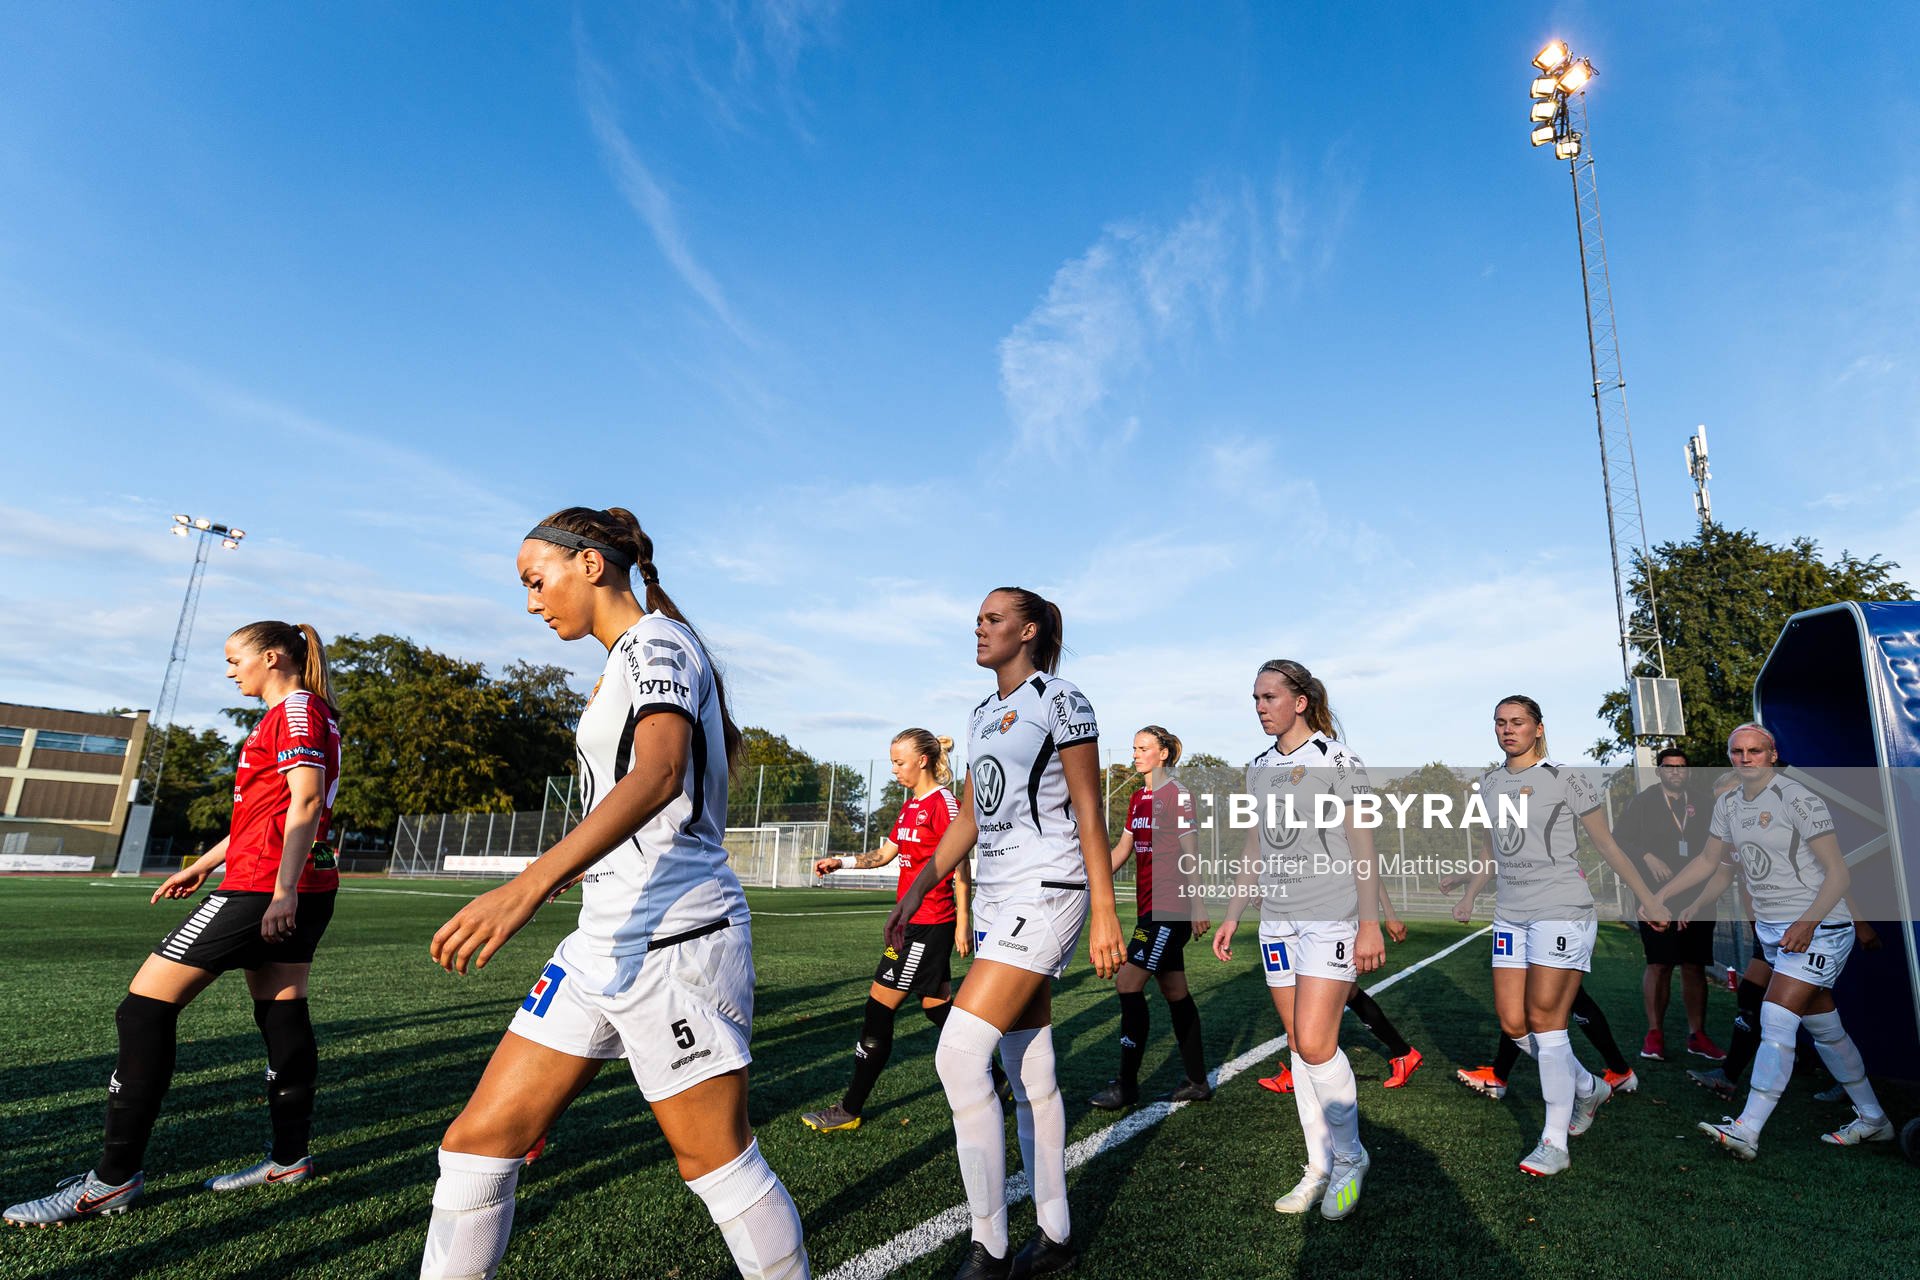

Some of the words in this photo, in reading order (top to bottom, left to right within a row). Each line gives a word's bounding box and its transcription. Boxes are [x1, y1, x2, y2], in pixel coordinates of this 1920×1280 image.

[1052, 694, 1067, 726] RASTA
[1333, 754, 1346, 781] RASTA
[1566, 776, 1584, 798] RASTA
[1790, 799, 1809, 821] RASTA
[1131, 817, 1160, 830] OBILL
[1010, 916, 1027, 937] 7
[1335, 941, 1345, 960] 8
[1556, 936, 1567, 951] 9
[1807, 952, 1826, 969] 10
[671, 1018, 696, 1050] 5
